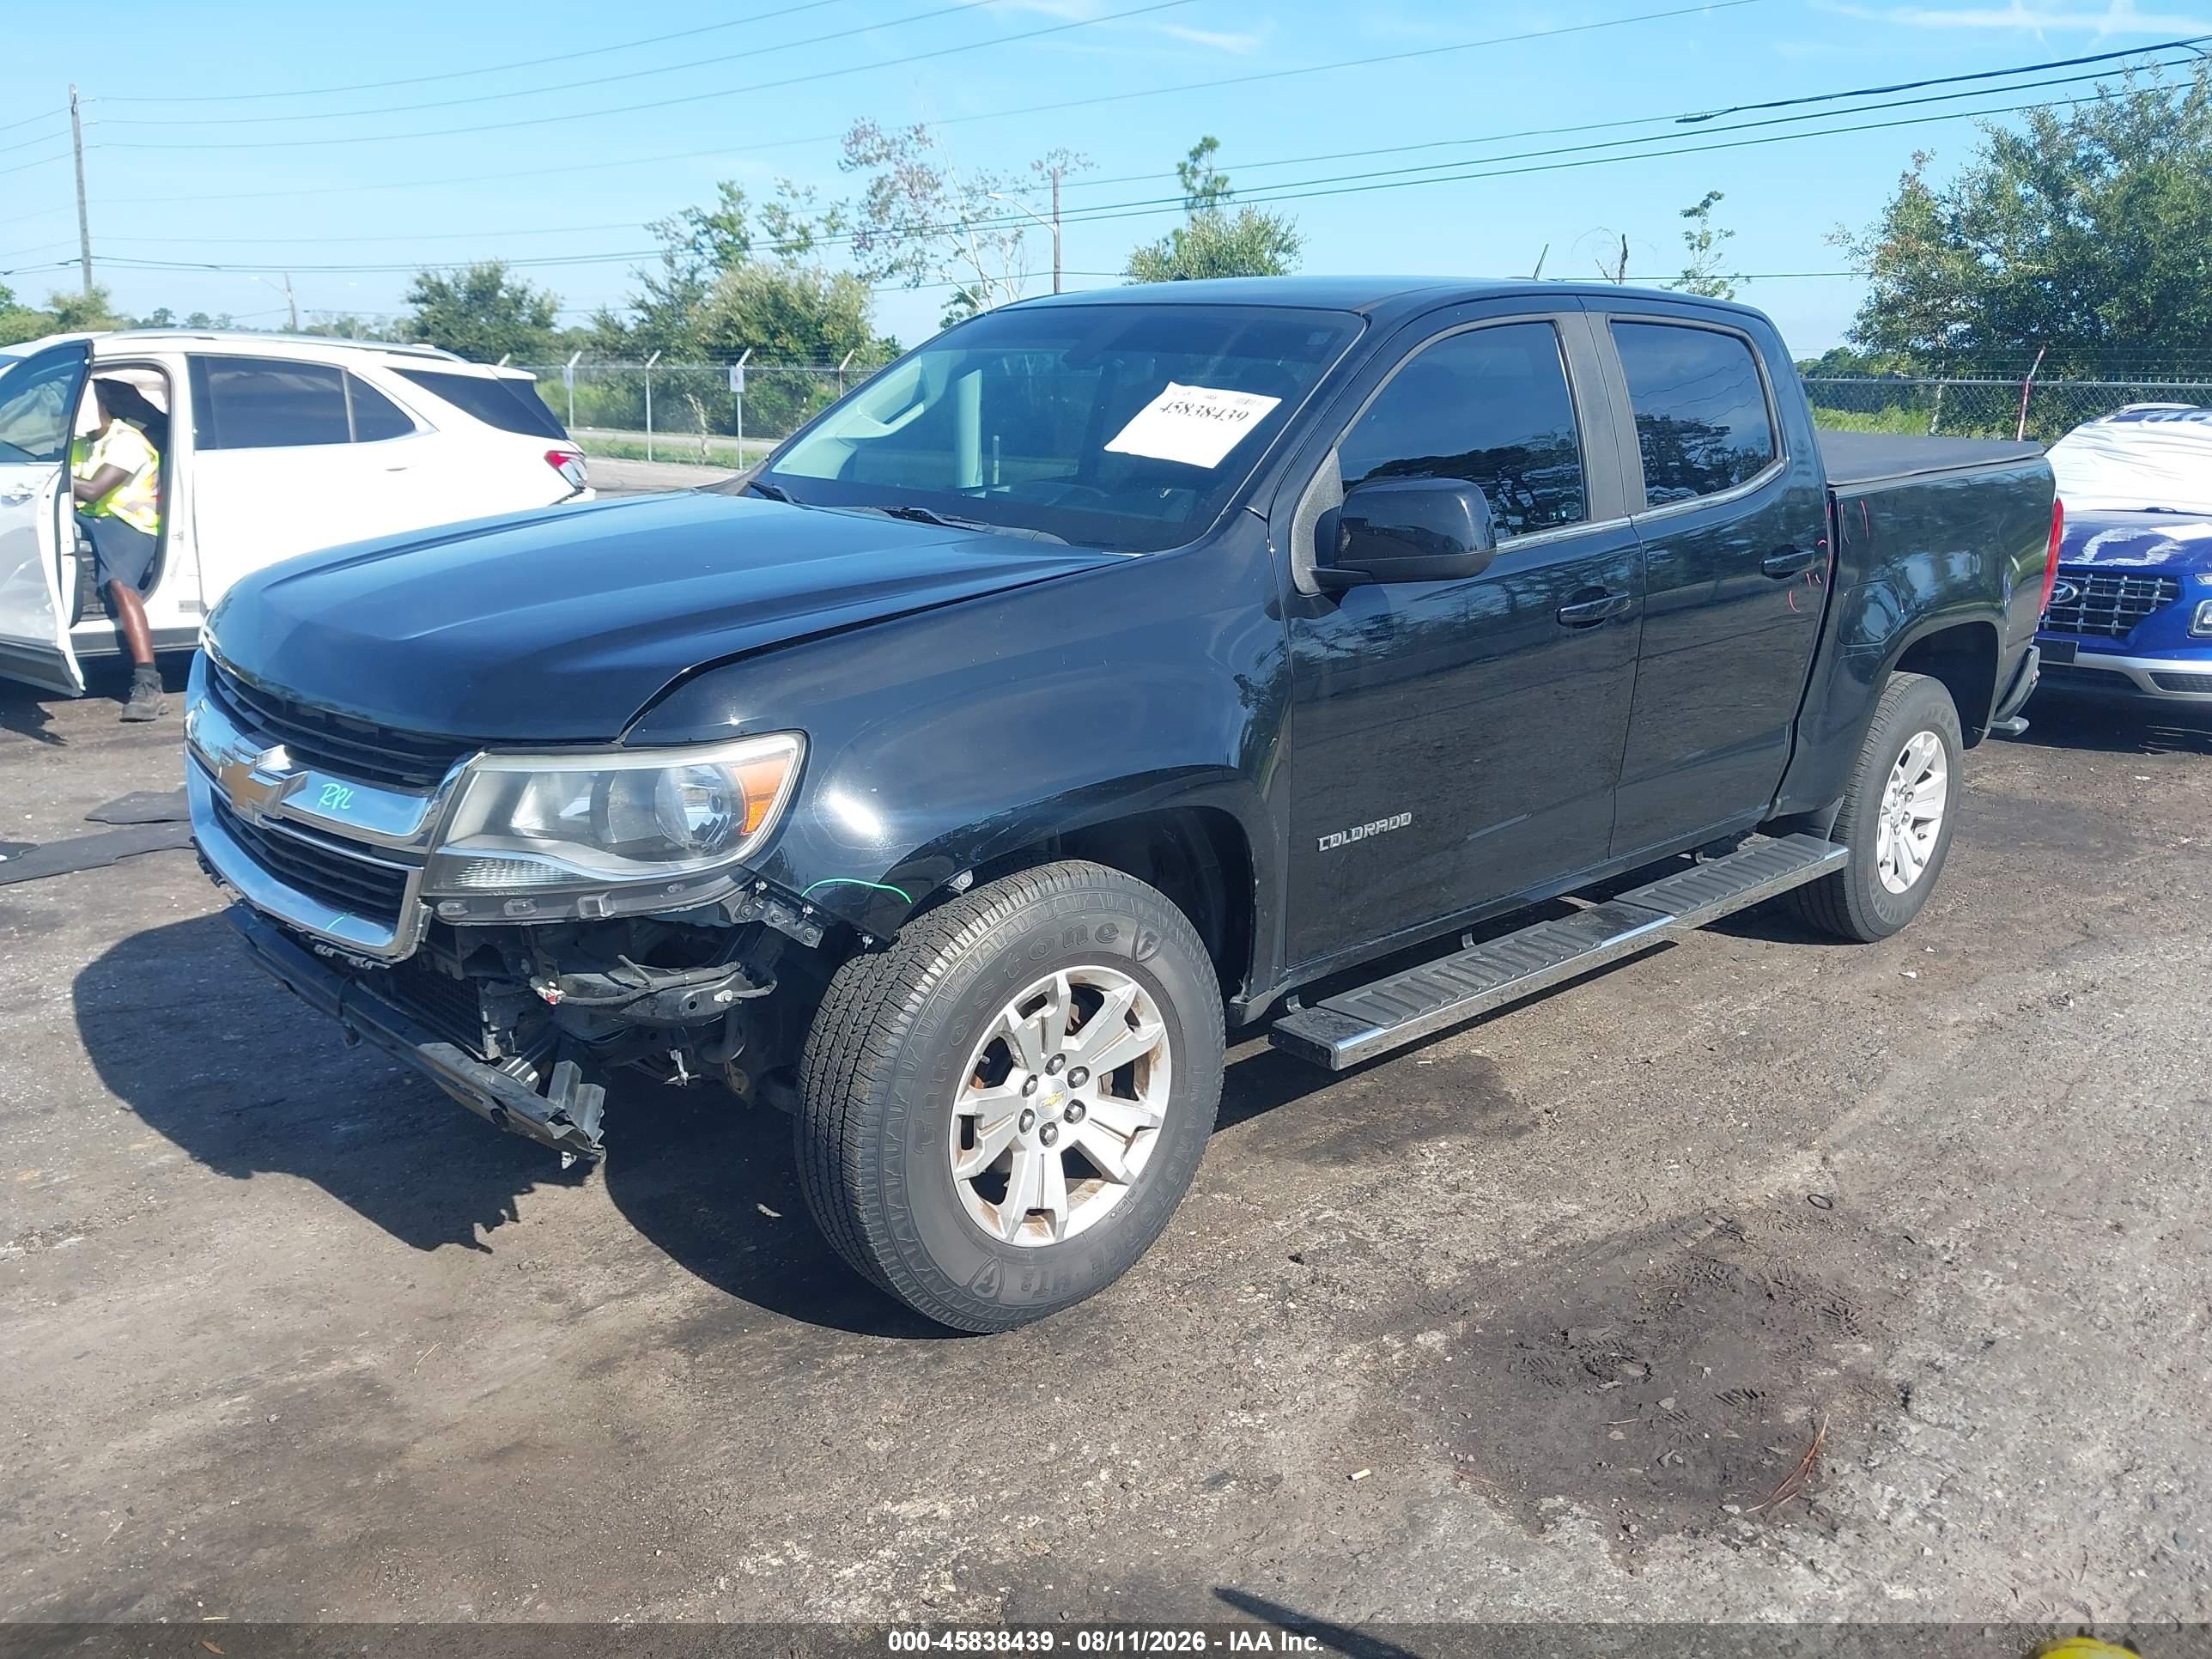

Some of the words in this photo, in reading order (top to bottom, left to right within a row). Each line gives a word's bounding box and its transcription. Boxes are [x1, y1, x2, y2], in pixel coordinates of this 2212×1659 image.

[1159, 400, 1249, 422] 45838439
[317, 782, 355, 810] RPL
[1316, 811, 1413, 852] COLORADO
